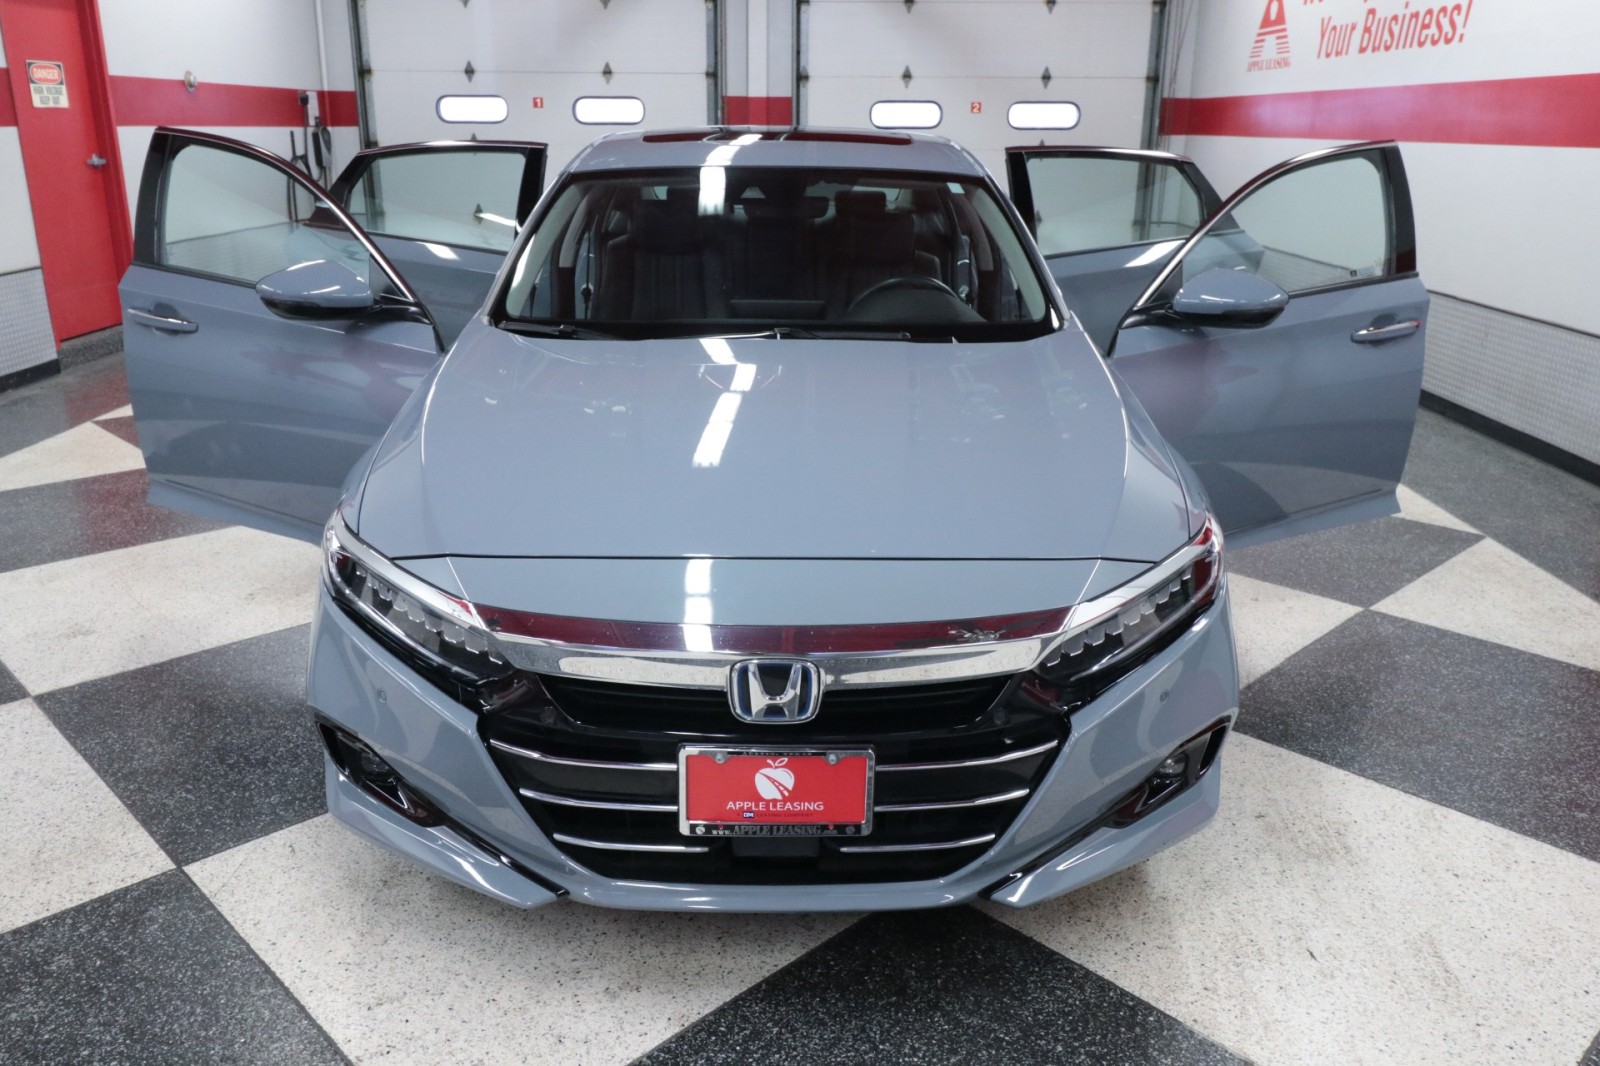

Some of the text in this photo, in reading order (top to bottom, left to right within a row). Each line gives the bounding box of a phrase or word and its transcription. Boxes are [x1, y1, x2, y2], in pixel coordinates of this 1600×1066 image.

[1317, 0, 1473, 59] Your Business!
[33, 67, 59, 80] DANGER
[33, 86, 63, 96] HIGH VOLTAGE
[40, 95, 50, 105] KEEP
[972, 103, 980, 113] 2
[726, 801, 824, 811] APPLE LEASING
